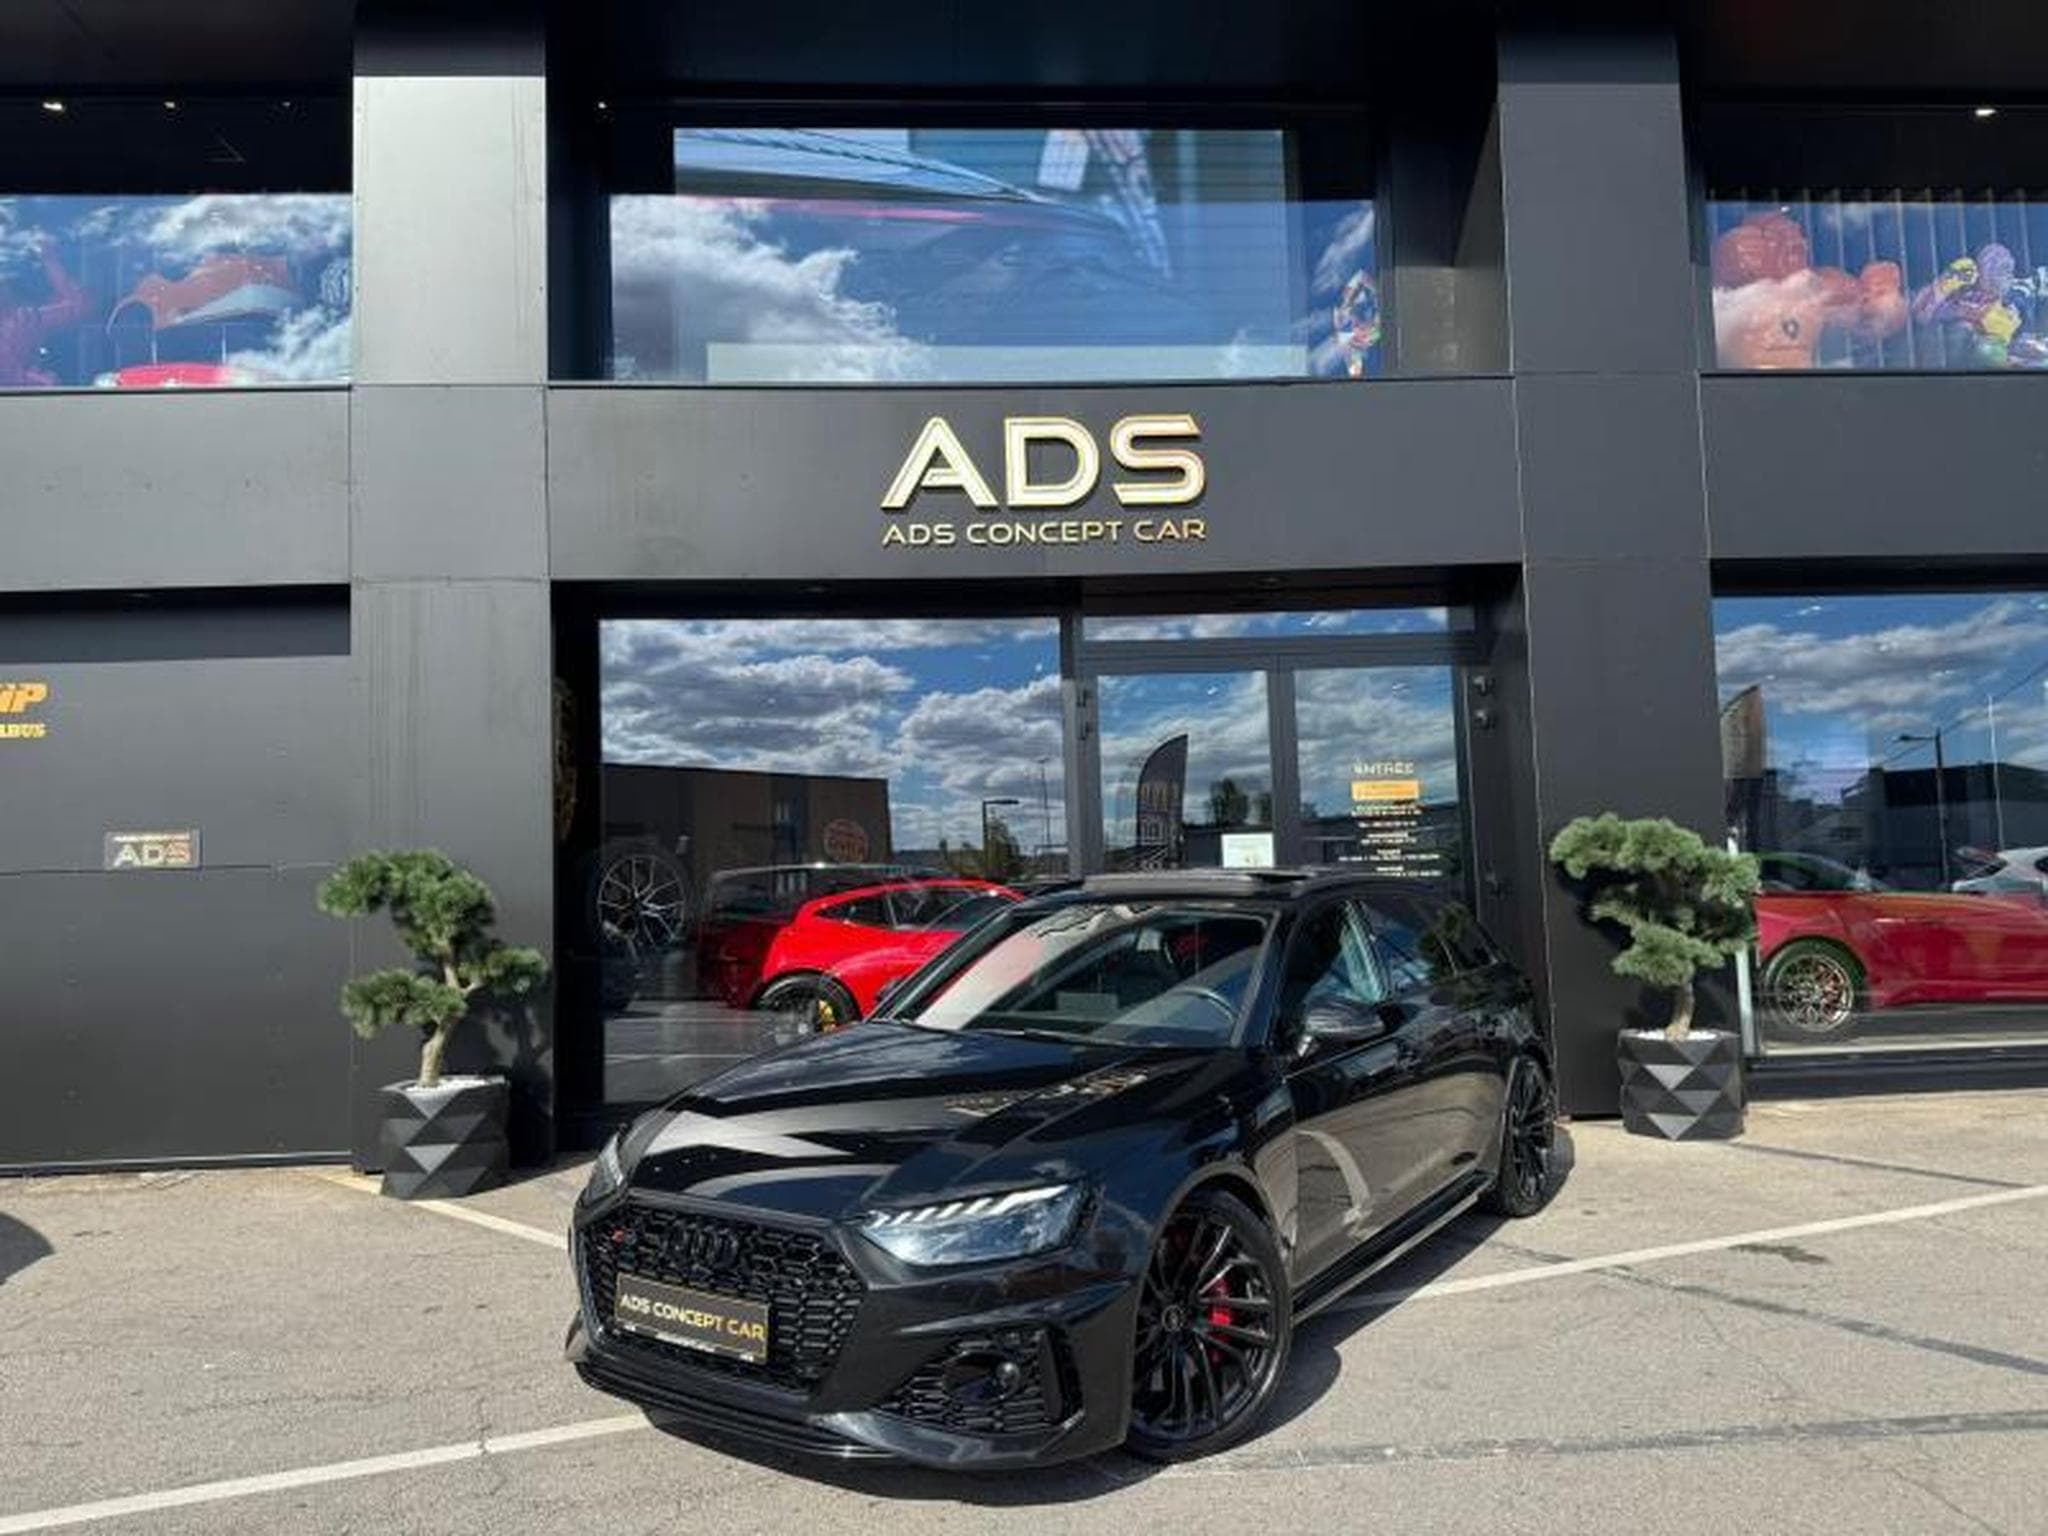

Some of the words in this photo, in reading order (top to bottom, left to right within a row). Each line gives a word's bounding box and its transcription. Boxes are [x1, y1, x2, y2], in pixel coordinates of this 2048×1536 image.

[880, 413, 1206, 508] ADS
[882, 522, 957, 546] ADS
[966, 520, 1123, 545] CONCEPT
[1133, 517, 1207, 542] CAR
[620, 1293, 652, 1315] ADS
[652, 1301, 724, 1332] CONCEPT
[727, 1319, 766, 1342] CAR
